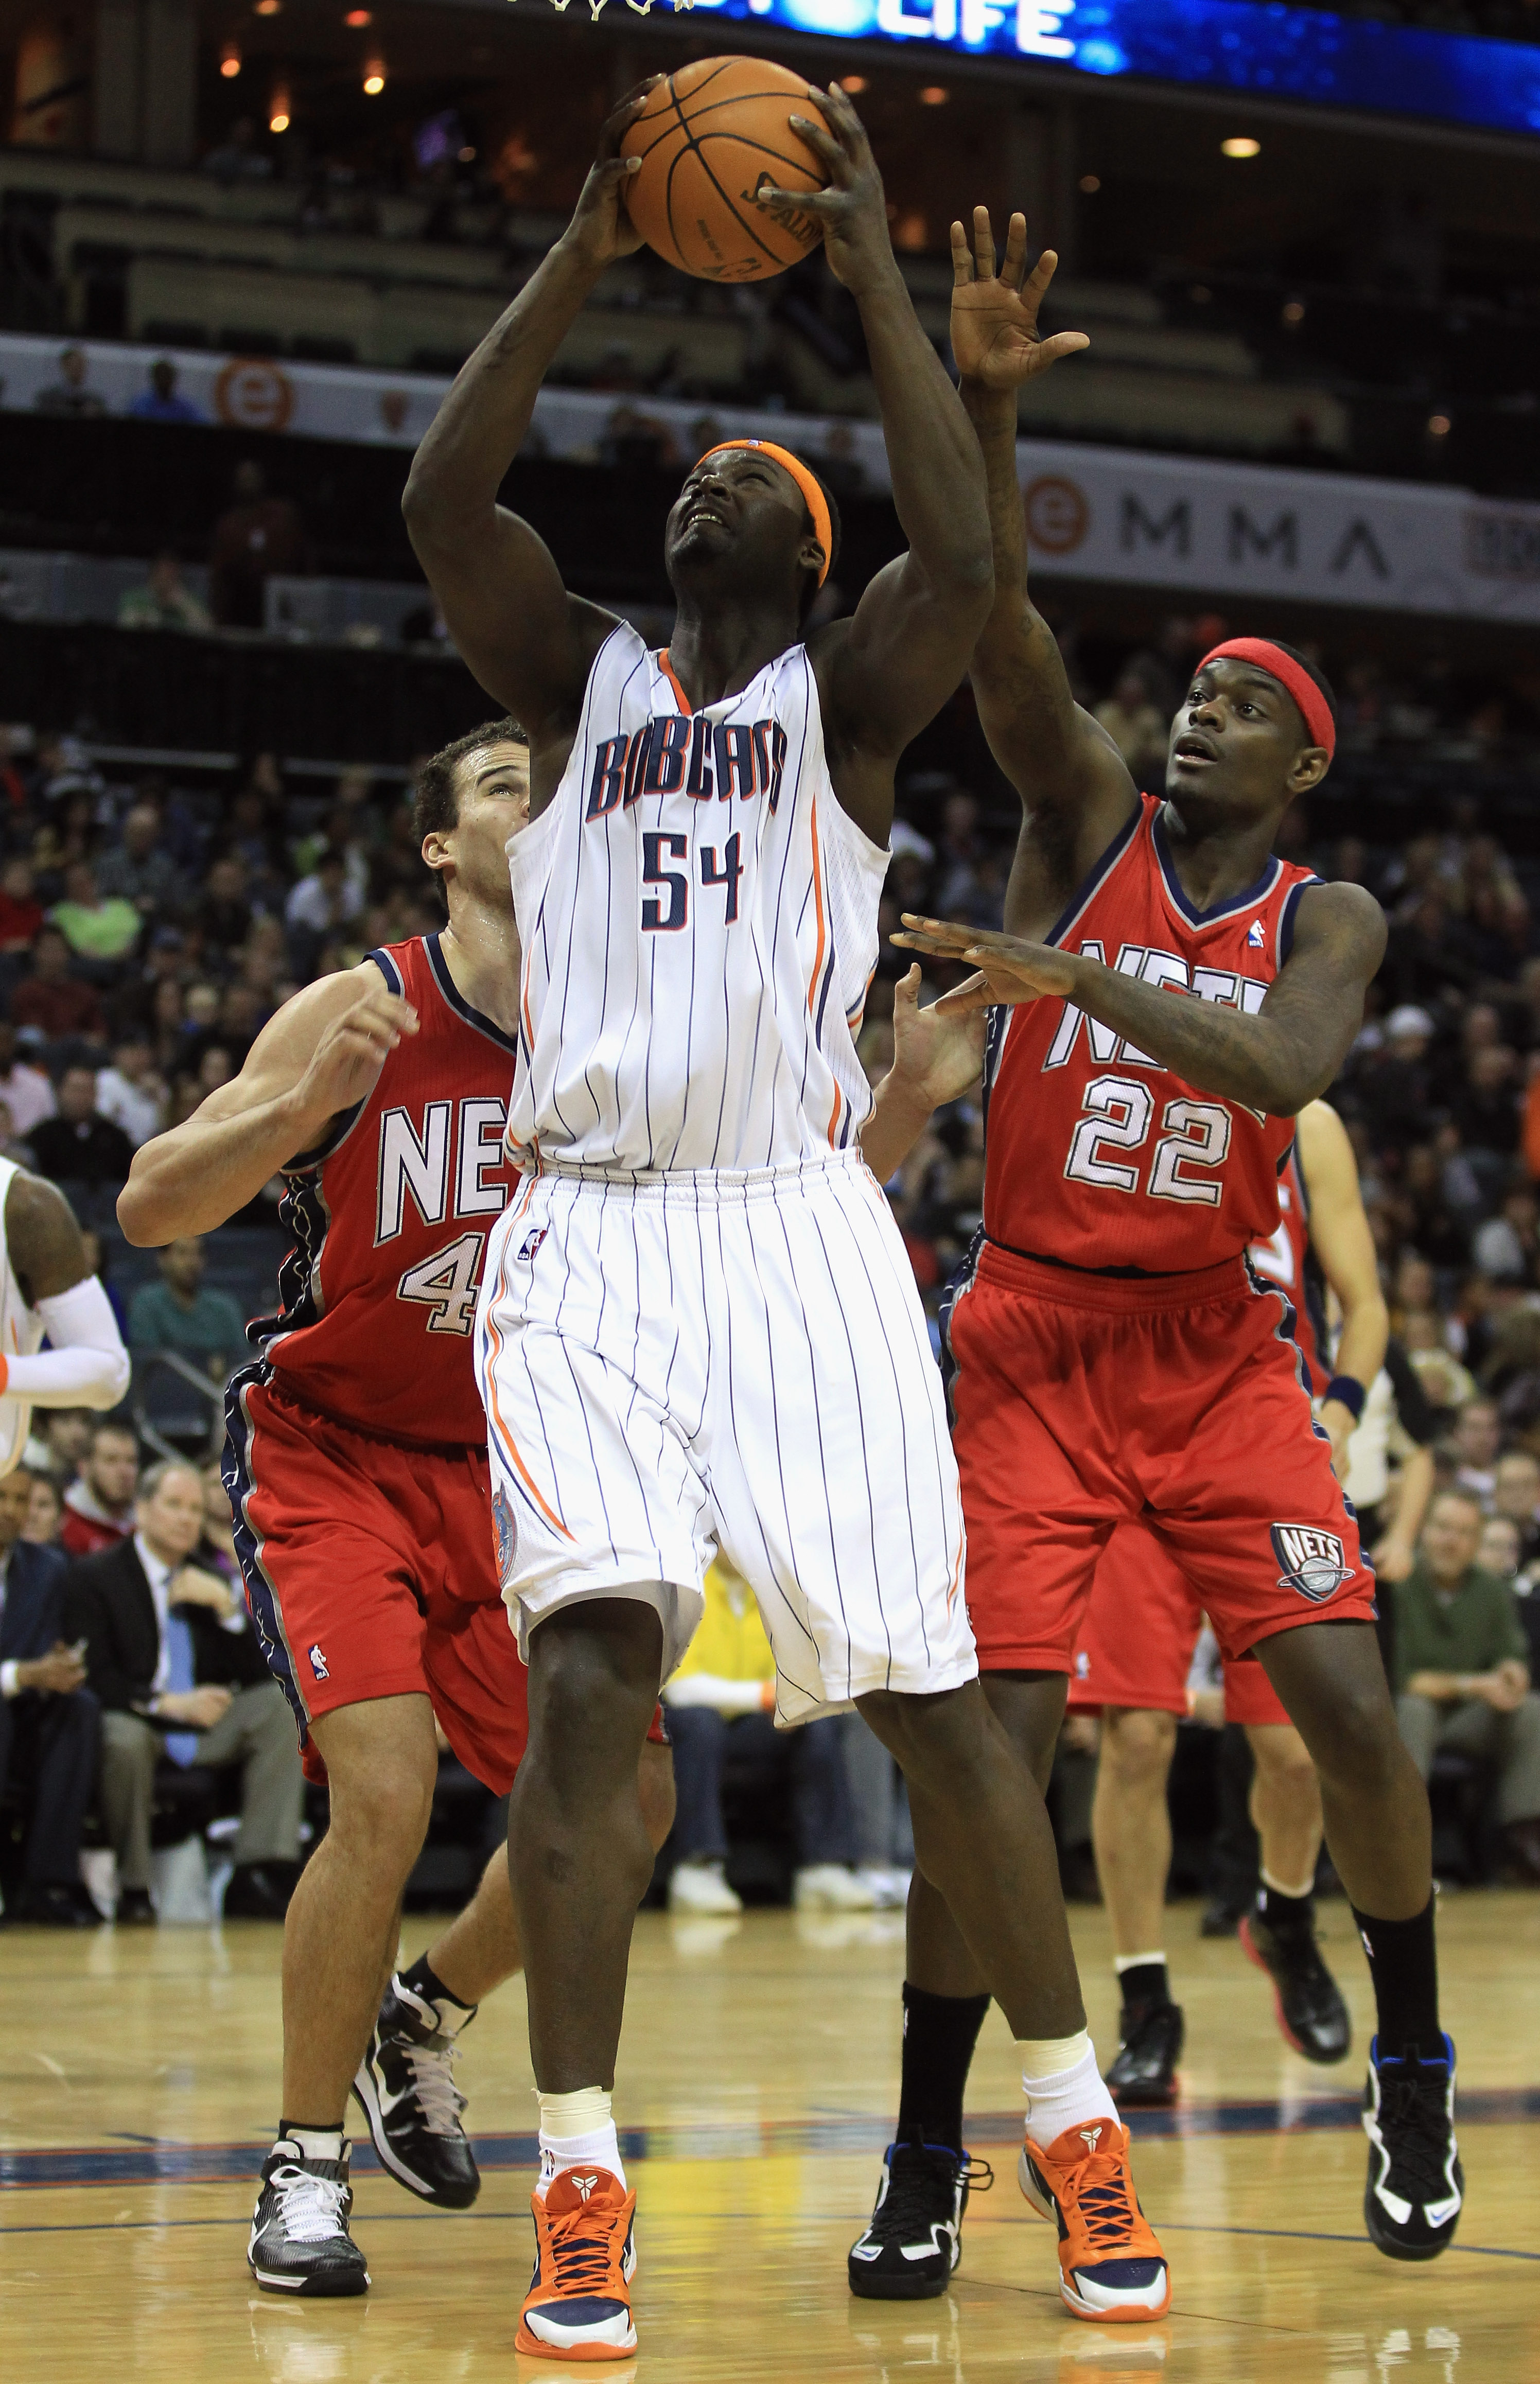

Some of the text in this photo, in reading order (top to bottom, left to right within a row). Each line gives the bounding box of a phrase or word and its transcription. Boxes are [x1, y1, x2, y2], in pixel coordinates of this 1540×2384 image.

[877, 0, 1075, 59] LIFE
[641, 831, 744, 932] 54
[1063, 1073, 1233, 1208] 22
[396, 1231, 486, 1338] 4
[1279, 1528, 1341, 1572] NETS
[316, 1671, 327, 1680] NBA
